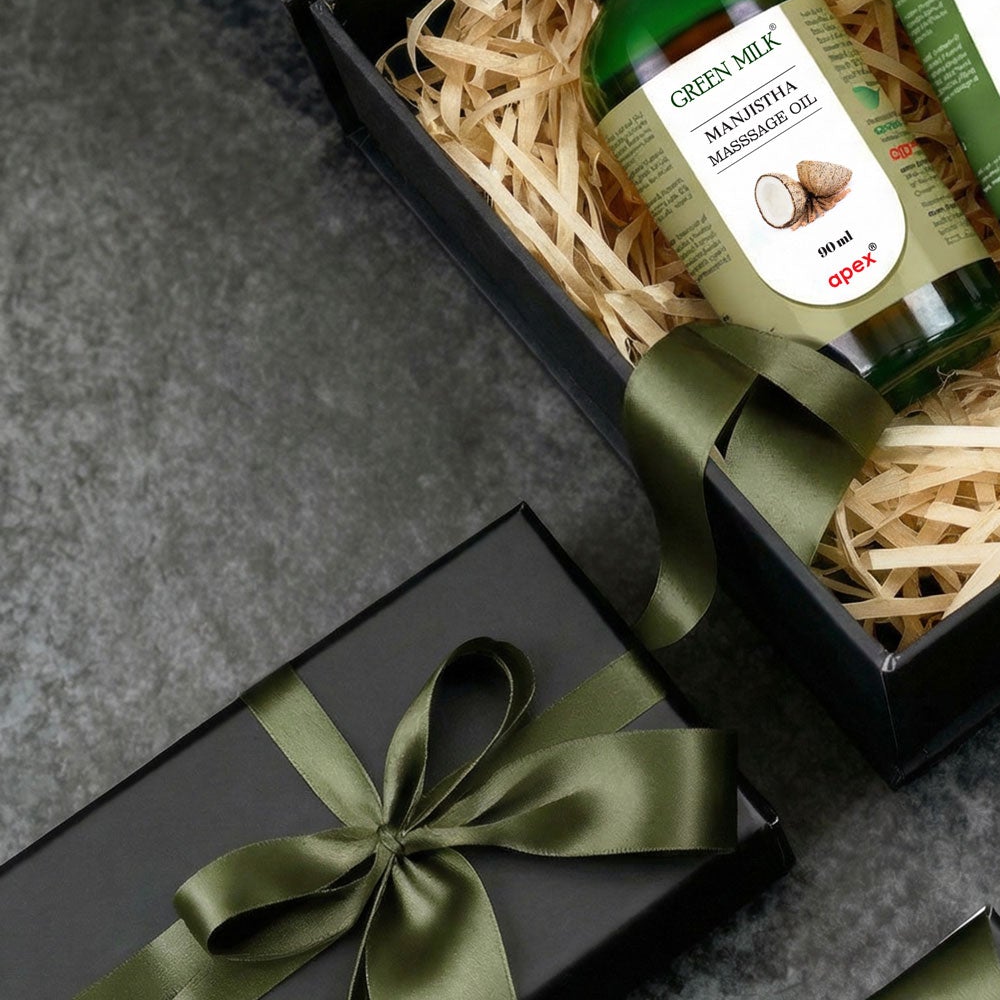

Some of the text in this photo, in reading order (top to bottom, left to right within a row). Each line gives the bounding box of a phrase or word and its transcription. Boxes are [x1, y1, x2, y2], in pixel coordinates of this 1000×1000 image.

[671, 61, 732, 107] GREEN
[705, 82, 797, 143] MANJISTHA
[708, 94, 817, 166] MASSSAGE OIL
[818, 230, 853, 257] 90 ml
